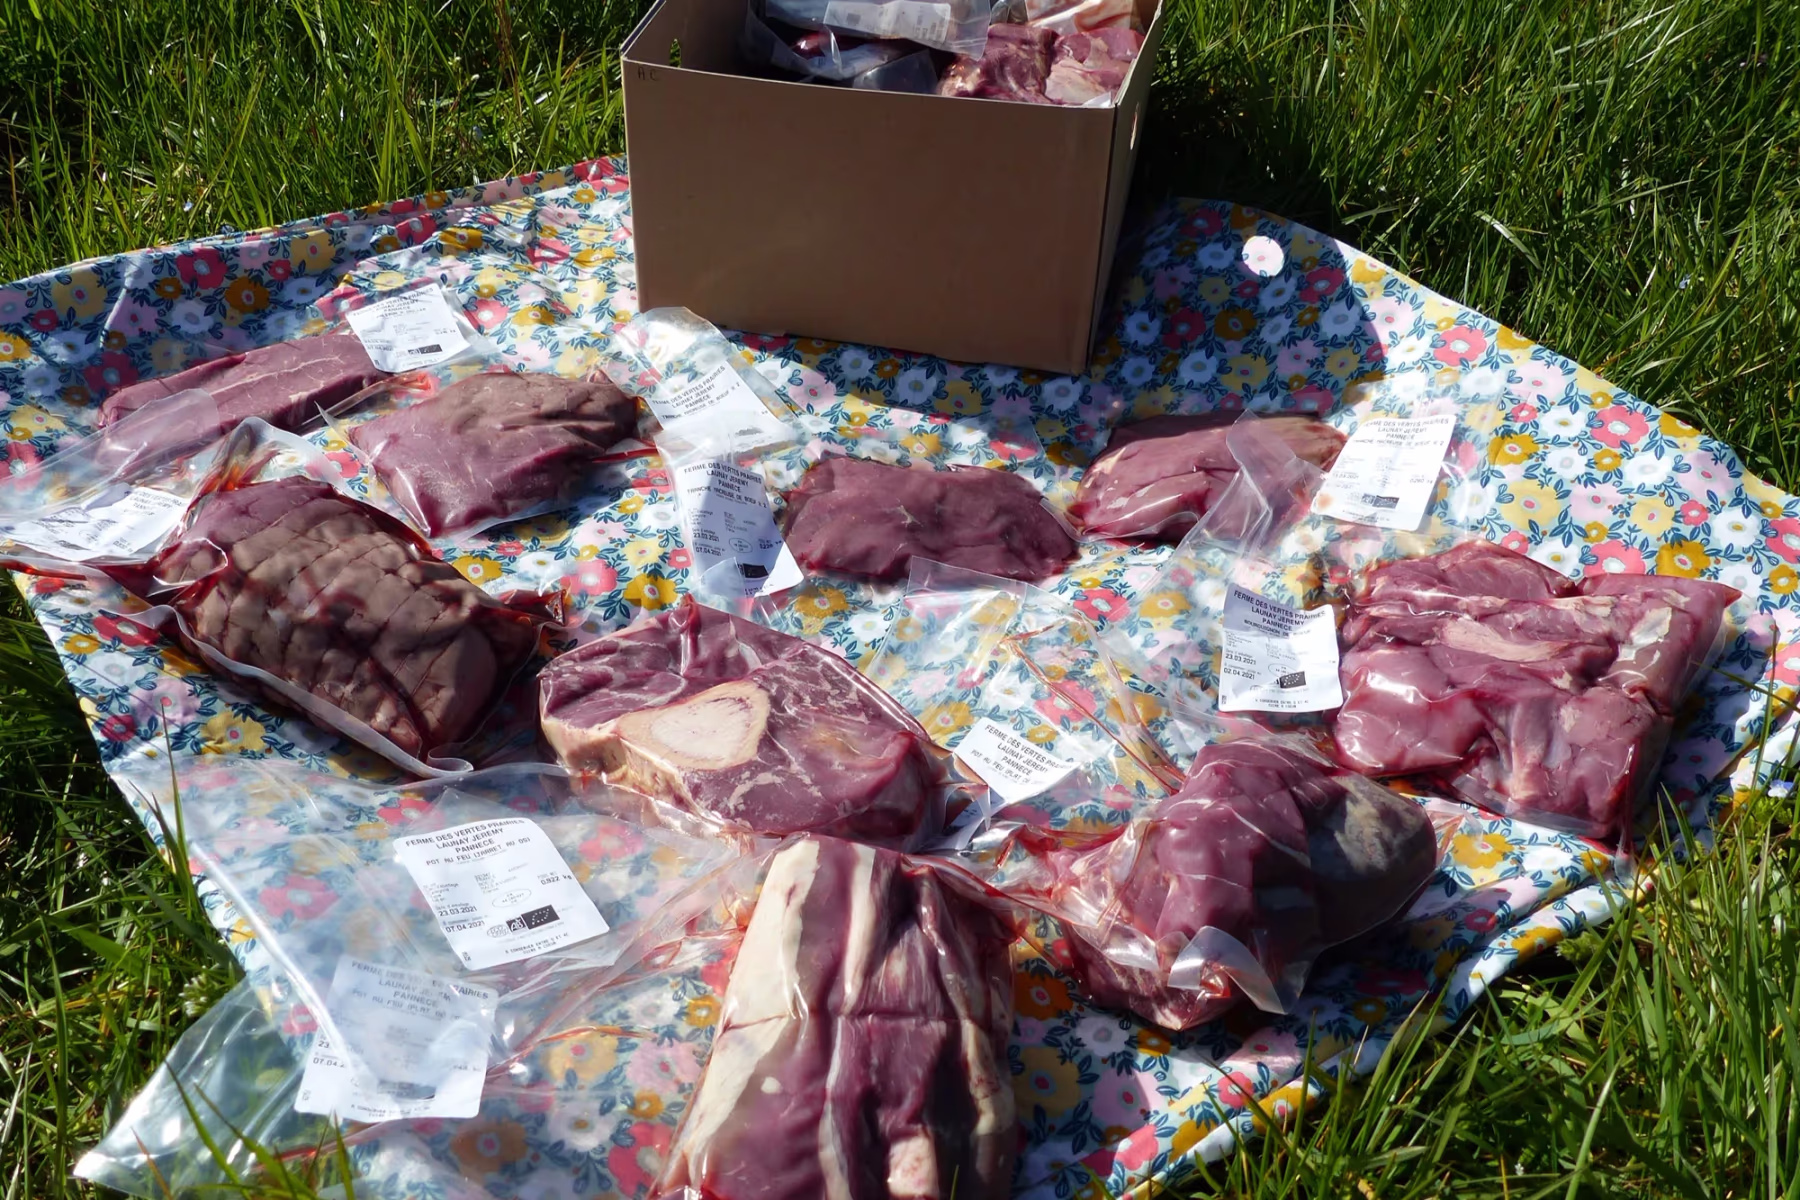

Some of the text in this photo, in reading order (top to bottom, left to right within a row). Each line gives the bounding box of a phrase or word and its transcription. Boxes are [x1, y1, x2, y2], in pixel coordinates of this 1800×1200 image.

[670, 395, 683, 403] DES
[682, 384, 704, 397] VERTES
[703, 366, 726, 386] PRAIRIES
[672, 384, 715, 408] LAUNAY JEREMY
[685, 394, 712, 409] PANNECE
[684, 463, 707, 474] FERME
[721, 464, 740, 476] VERTES
[706, 470, 729, 480] LAUNAY
[718, 479, 741, 492] PANNECE
[1234, 590, 1254, 604] FERME
[1255, 599, 1268, 609] DES
[1269, 604, 1294, 618] VERTES
[1251, 606, 1305, 626] LAUNAY JEREMY
[1262, 618, 1293, 631] PANNECE
[1225, 653, 1257, 665] 23.03.2021
[1223, 667, 1255, 680] 02.04.2021
[985, 724, 1008, 741] FERME
[1008, 737, 1021, 748] DES
[1021, 745, 1047, 763] VERTES
[970, 749, 983, 758] POT
[983, 756, 991, 764] AU
[992, 761, 1005, 771] FEU
[997, 742, 1049, 773] LAUNAY JEREMY
[1001, 755, 1033, 776] PANNECE
[406, 819, 525, 847] FERME DES VERTES PRAIRIES
[436, 827, 504, 850] LAUNAY JEREMY
[455, 838, 495, 853] PANNECE
[426, 858, 440, 866] POT
[456, 853, 471, 862] FEU
[438, 906, 477, 917] 23.03.2021
[445, 920, 485, 933] 07.04.2021
[352, 961, 382, 975] FERME
[379, 979, 417, 993] LAUNAY
[393, 991, 438, 1007] PANNECE
